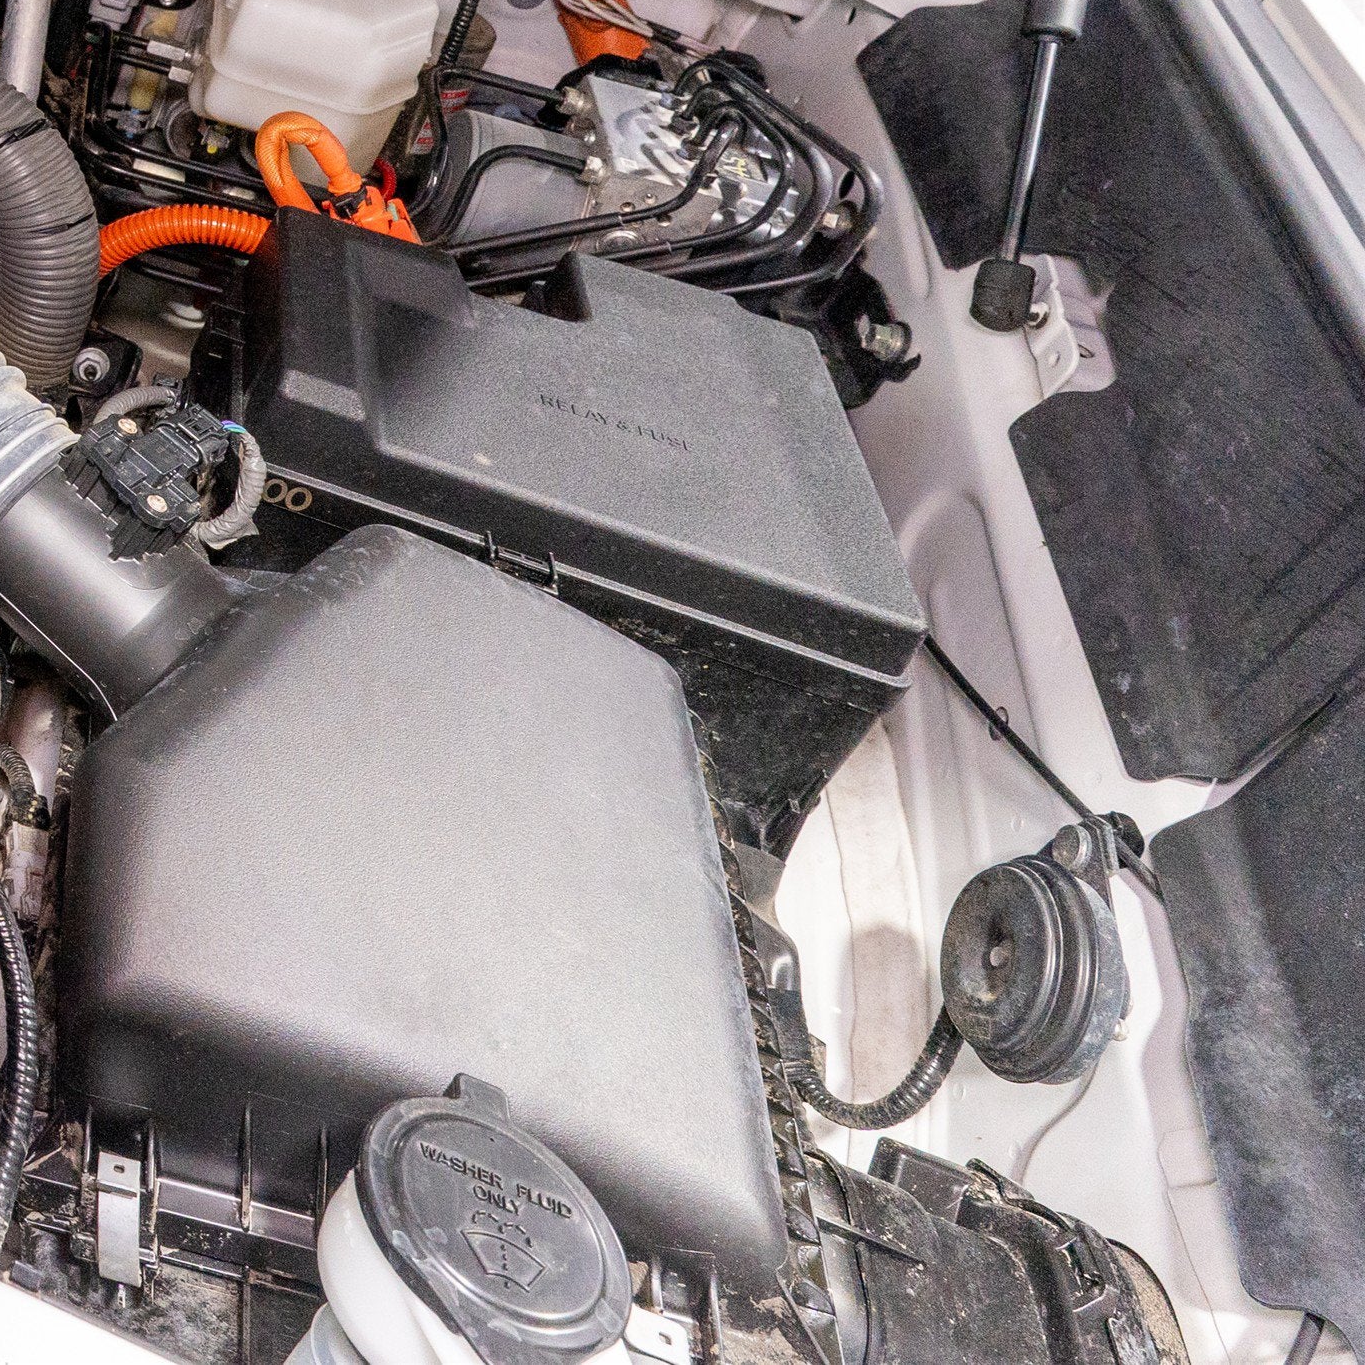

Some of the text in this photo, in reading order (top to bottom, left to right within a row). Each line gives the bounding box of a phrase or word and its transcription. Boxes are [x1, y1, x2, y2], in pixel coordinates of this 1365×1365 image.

[539, 394, 610, 425] RELAY
[419, 1142, 573, 1220] WASHER FLUID
[472, 1185, 520, 1216] ONLY
